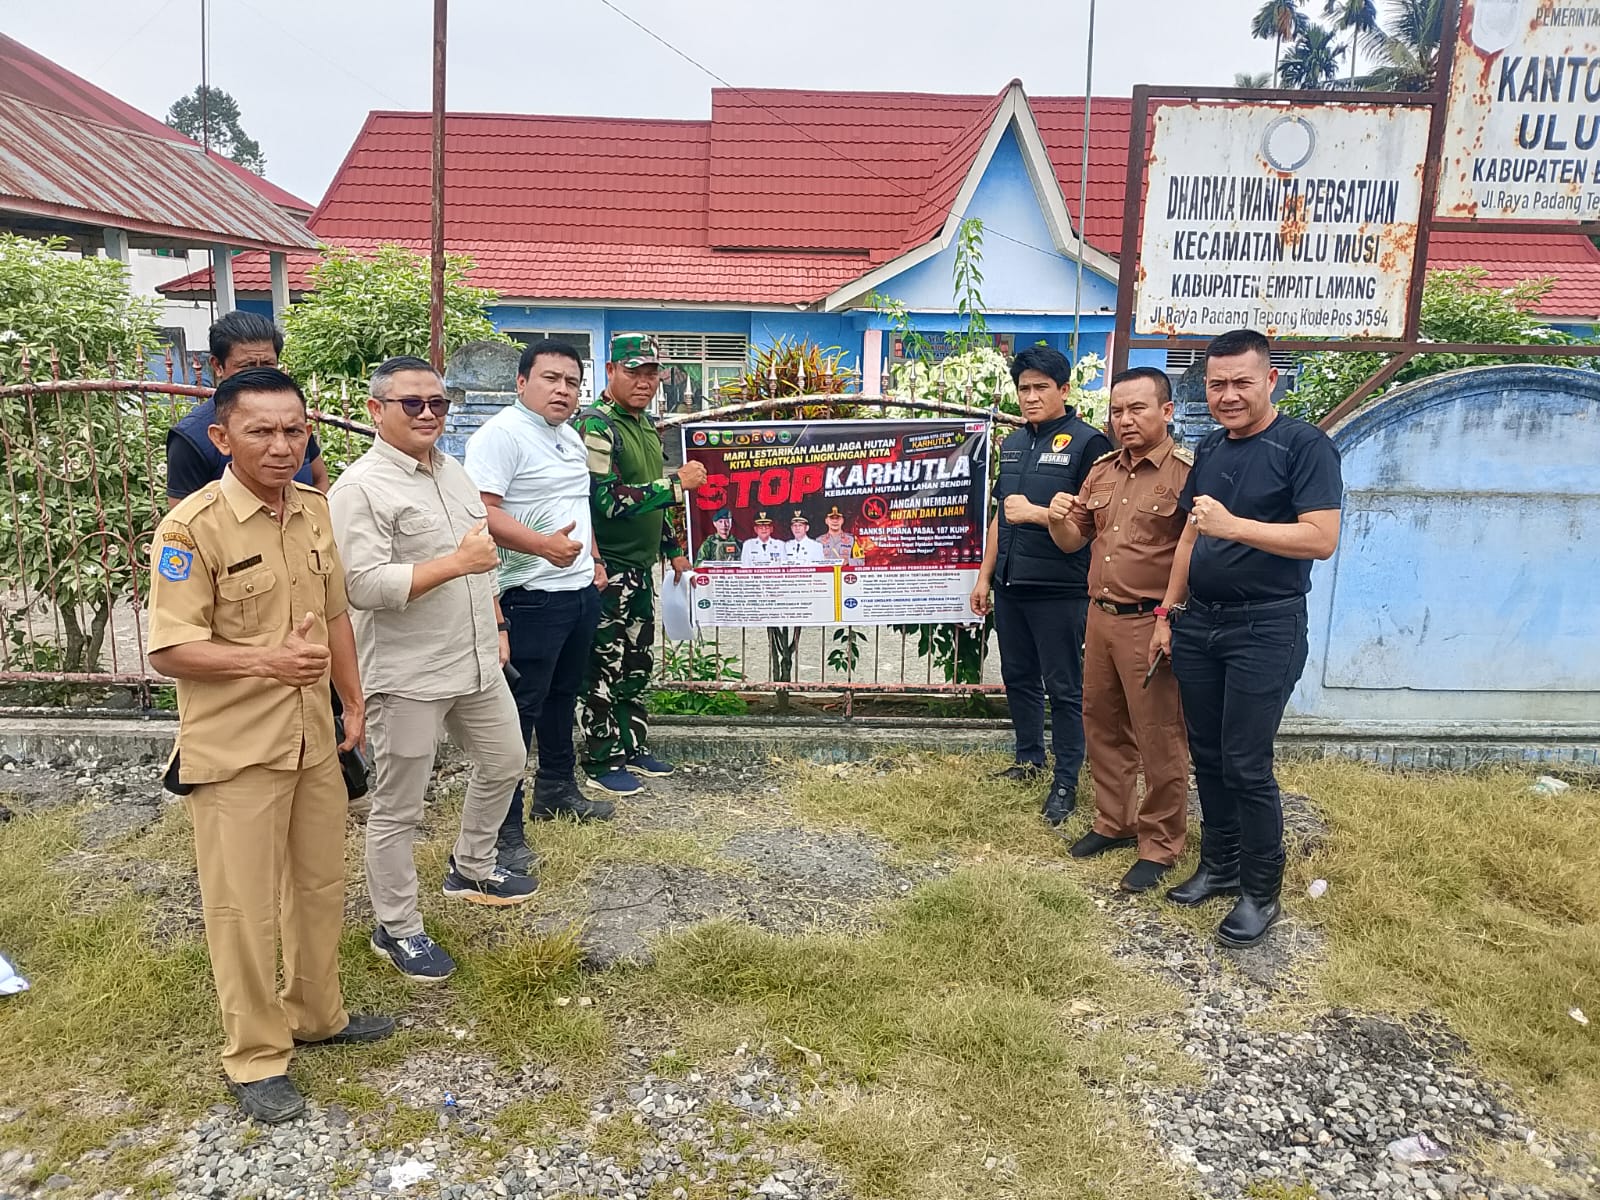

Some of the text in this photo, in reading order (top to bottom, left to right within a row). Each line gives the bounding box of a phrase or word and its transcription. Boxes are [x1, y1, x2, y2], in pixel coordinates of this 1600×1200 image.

[1535, 7, 1600, 27] PEMERINTA
[1518, 113, 1600, 151] ULU
[1472, 157, 1588, 184] KABUPATEN
[1166, 175, 1400, 224] DHARMA WANITA PERSATUAN
[1533, 190, 1582, 215] Padang
[1172, 230, 1381, 265] KECAMATAN ULU MUSI
[1170, 273, 1377, 301] KABUPATEN EMPAT LAWANG
[1166, 306, 1198, 329] Raya
[1201, 306, 1249, 329] Padang
[1252, 307, 1298, 331] Tepong
[1299, 307, 1330, 327] Kode
[1331, 309, 1353, 328] Pos
[1354, 308, 1390, 329] 31594
[723, 451, 748, 462] MARI
[749, 446, 807, 460] LESTARIKAN
[808, 443, 836, 454] ALAM
[836, 440, 861, 452] JAGA
[863, 438, 897, 449] HUTAN
[912, 437, 952, 448] KARHUTLA
[729, 458, 751, 470] KITA
[753, 455, 803, 468] SEHATKAN
[804, 450, 867, 464] LINGKUNGAN
[868, 447, 891, 458] KITA
[824, 455, 971, 490] KARHUTLA
[696, 464, 826, 511] STOP
[824, 487, 874, 498] KEBAKARAN
[874, 485, 902, 494] HUTAN
[911, 482, 939, 491] LAHAN
[939, 479, 972, 489] SENDIRI
[889, 494, 969, 510] JANGAN MEMBAKAR
[890, 505, 966, 521] HUTAN DAN LAHAN
[859, 528, 885, 536] SANKSI
[886, 527, 912, 535] PIDANA
[913, 526, 935, 534] PASAL
[949, 526, 970, 534] KUHP
